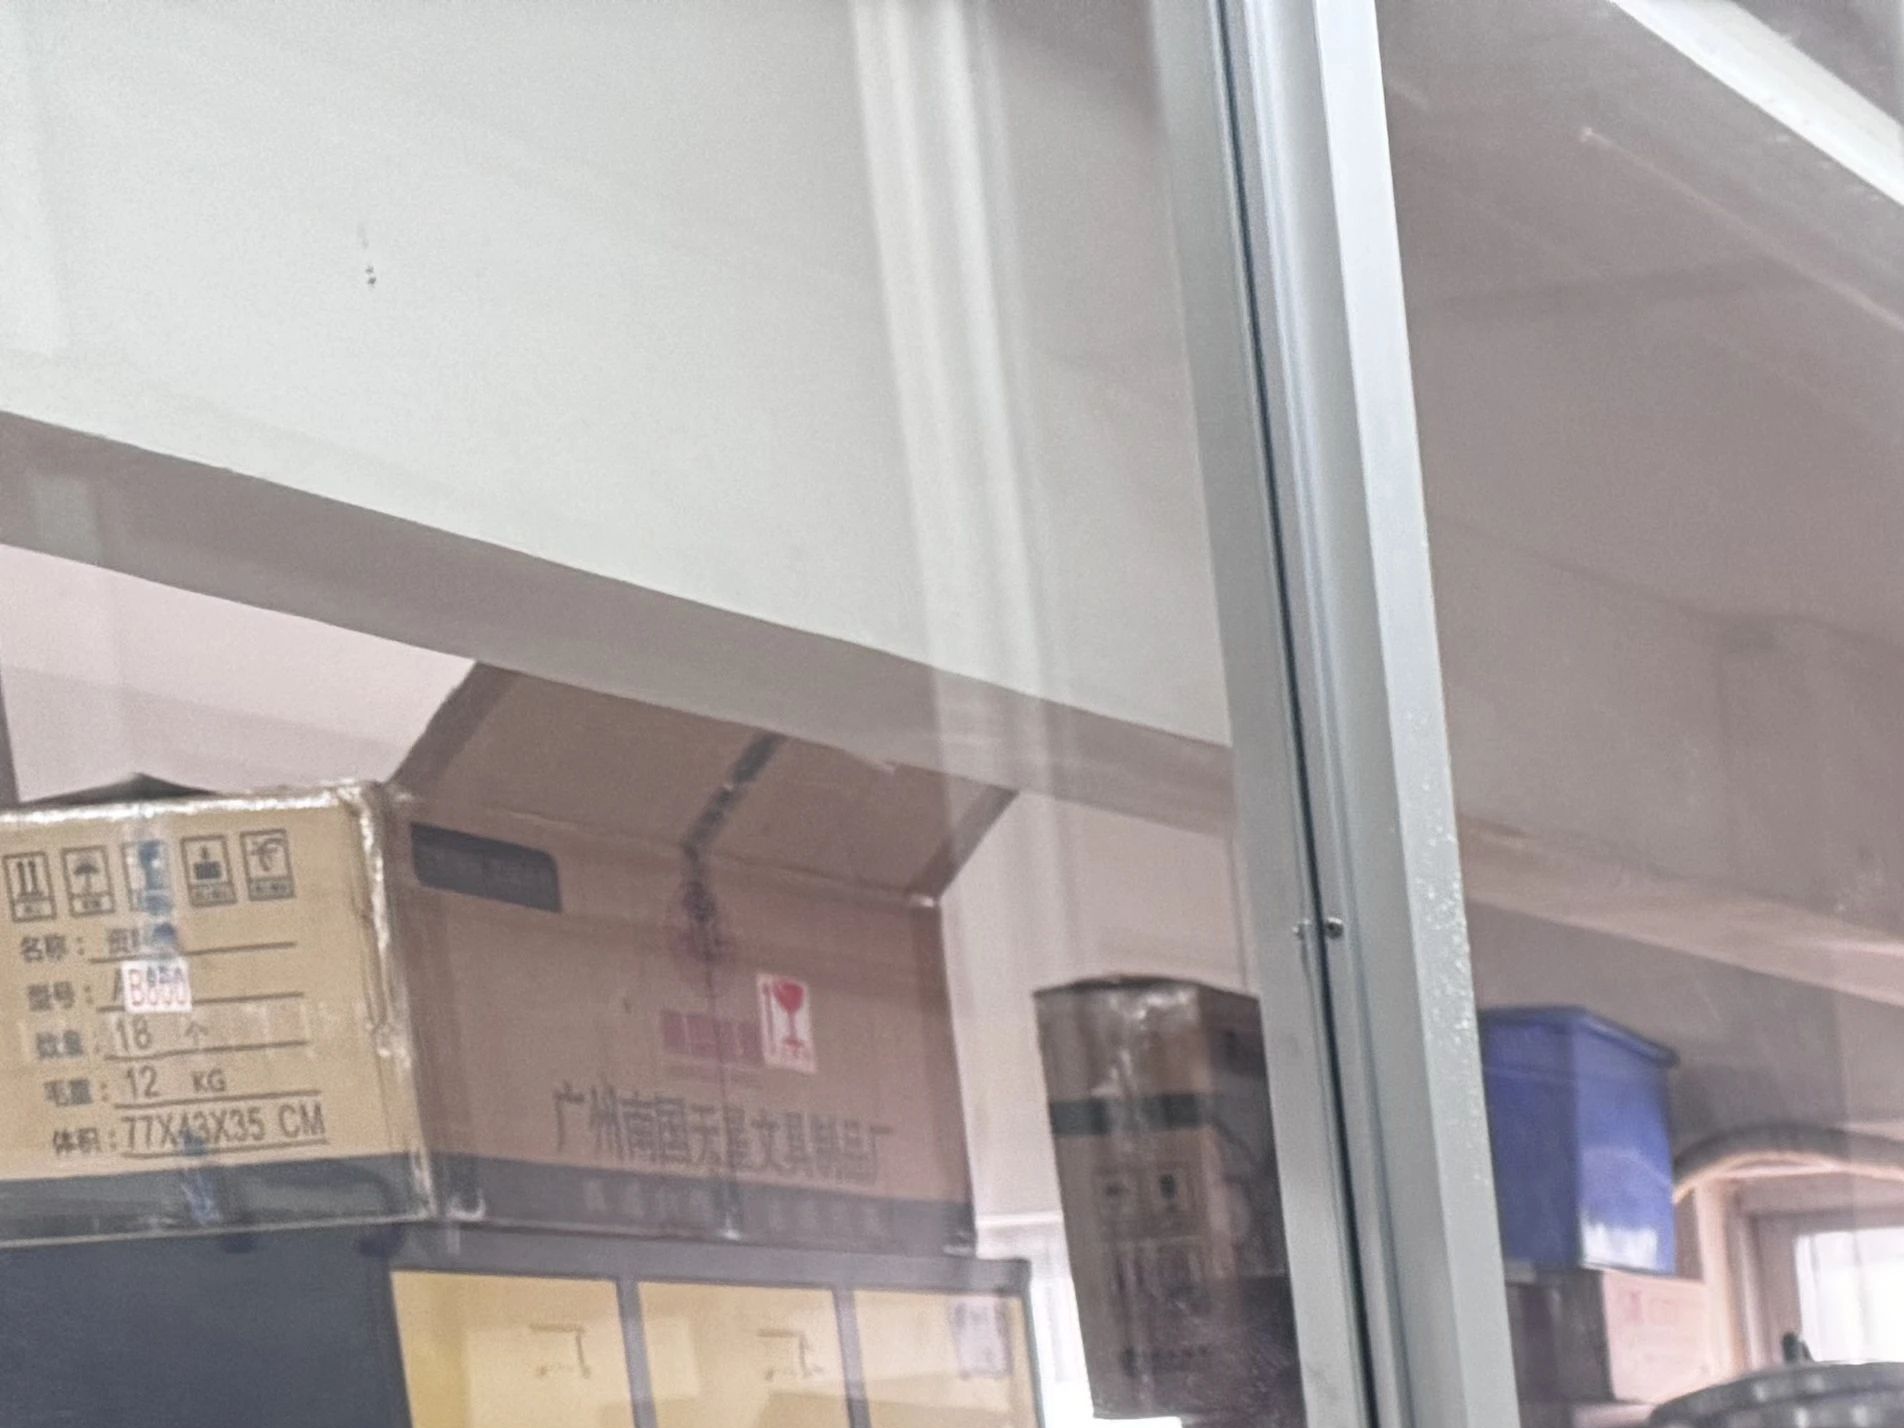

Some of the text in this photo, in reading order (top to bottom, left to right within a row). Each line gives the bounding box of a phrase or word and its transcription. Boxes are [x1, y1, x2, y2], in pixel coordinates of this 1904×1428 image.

[126, 1066, 160, 1099] 12
[192, 1068, 226, 1094] KG
[277, 1102, 327, 1139] CM
